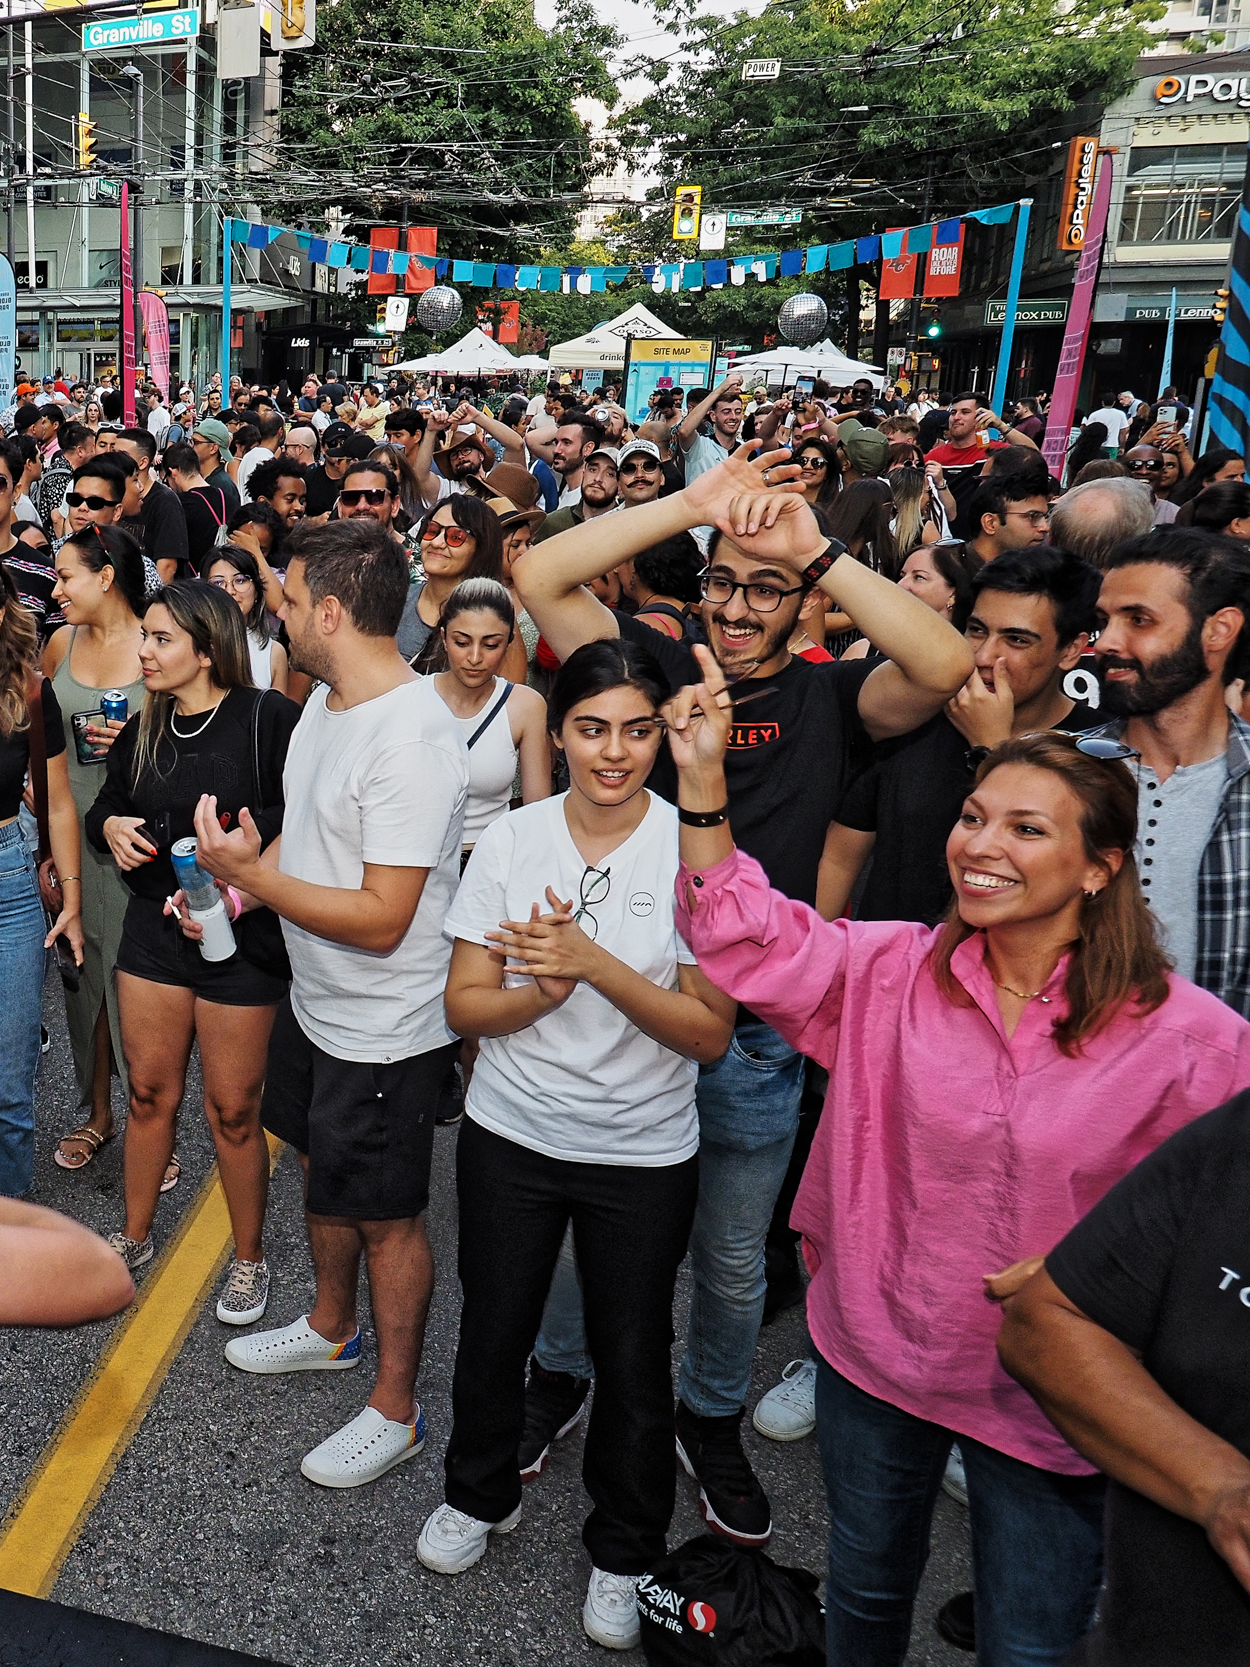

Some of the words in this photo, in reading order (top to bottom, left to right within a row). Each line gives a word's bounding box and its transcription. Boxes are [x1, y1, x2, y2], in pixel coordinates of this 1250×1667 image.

[89, 22, 164, 46] Granville
[171, 14, 192, 35] St
[747, 62, 777, 73] POWER
[1072, 141, 1096, 224] Payless
[932, 247, 958, 261] ROAR
[1041, 311, 1063, 320] PUB
[1135, 309, 1160, 318] PUB
[291, 337, 310, 347] Lids
[653, 347, 671, 355] SITE
[672, 347, 691, 355] MAP
[931, 358, 940, 371] 4
[1063, 669, 1100, 710] 9
[649, 1609, 665, 1625] for
[665, 1617, 683, 1634] life
